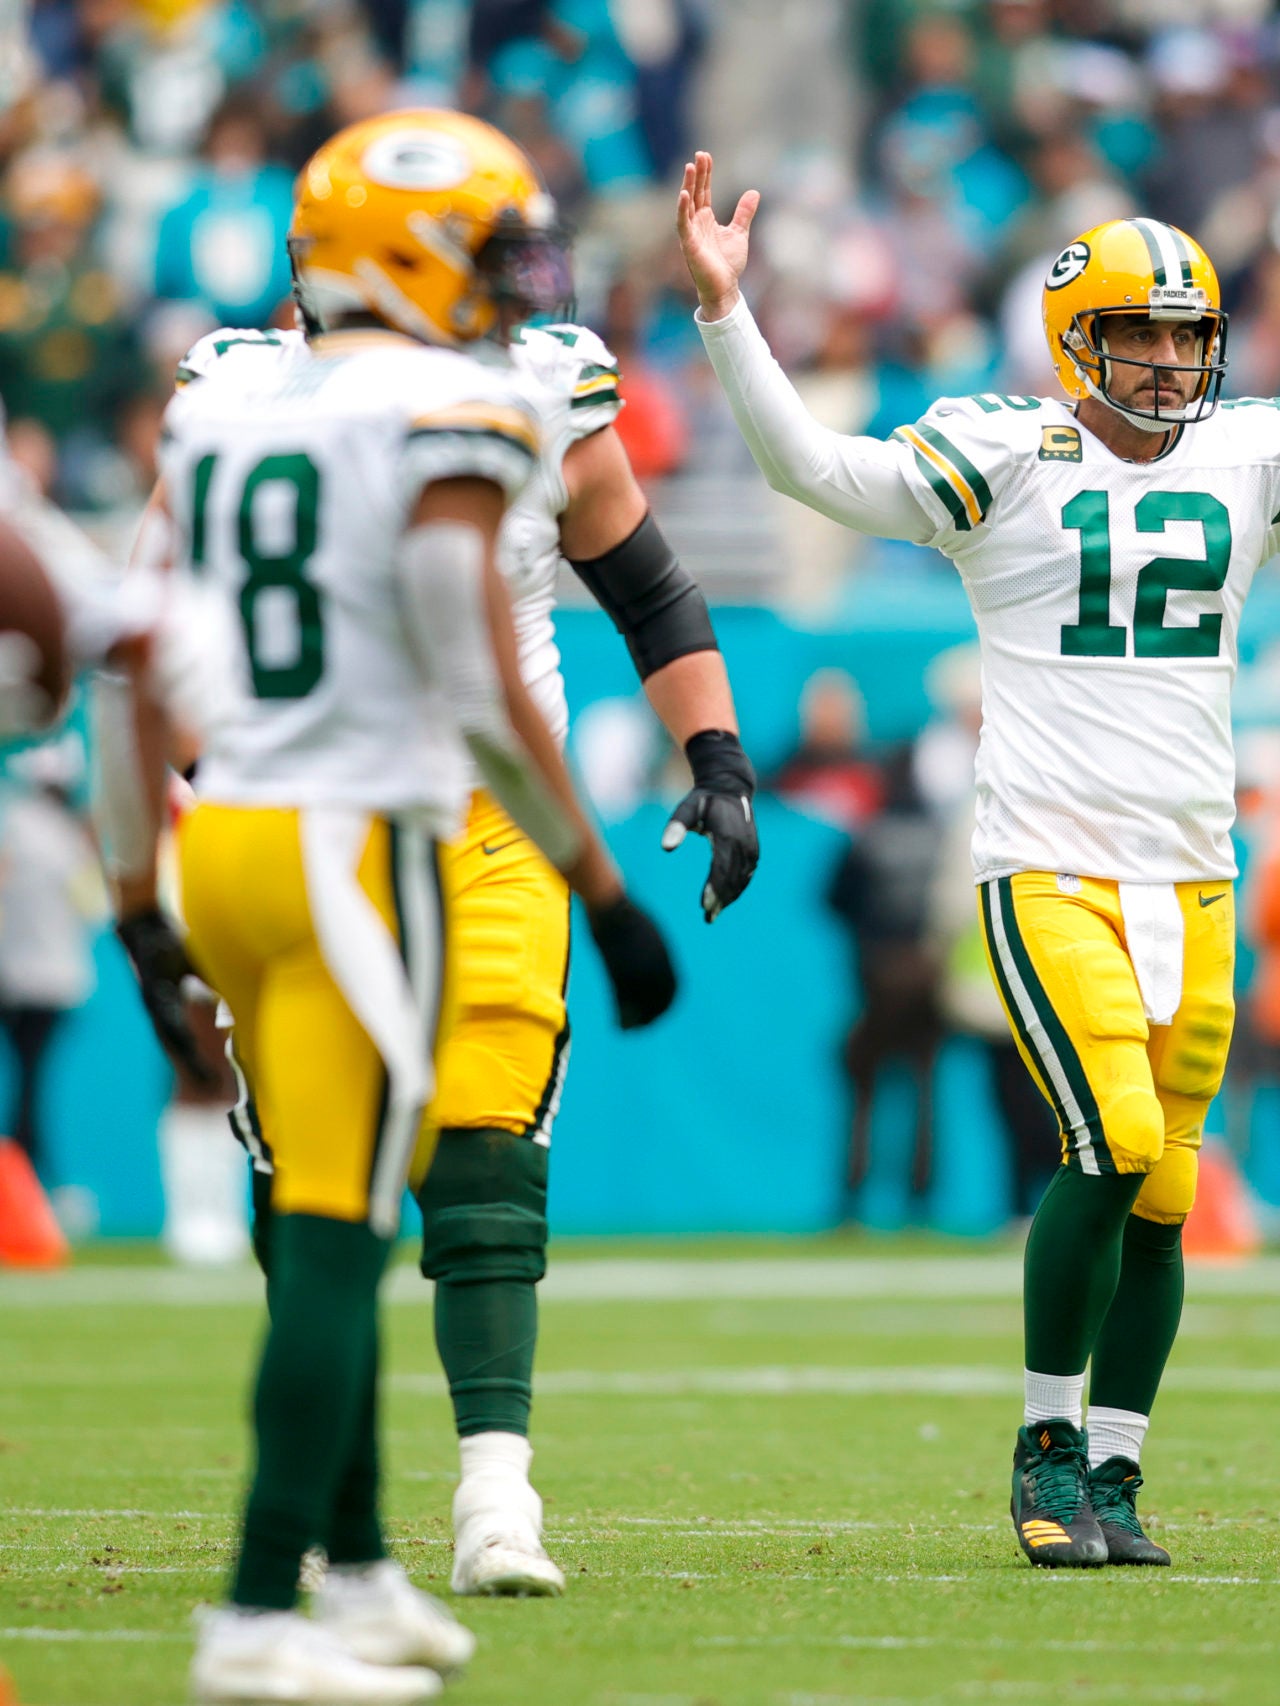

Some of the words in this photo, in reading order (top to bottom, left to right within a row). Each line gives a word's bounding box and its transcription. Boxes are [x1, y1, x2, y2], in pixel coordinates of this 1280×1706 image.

[1163, 290, 1188, 299] PACKERS
[190, 450, 327, 699] 18
[1060, 489, 1232, 657] 12
